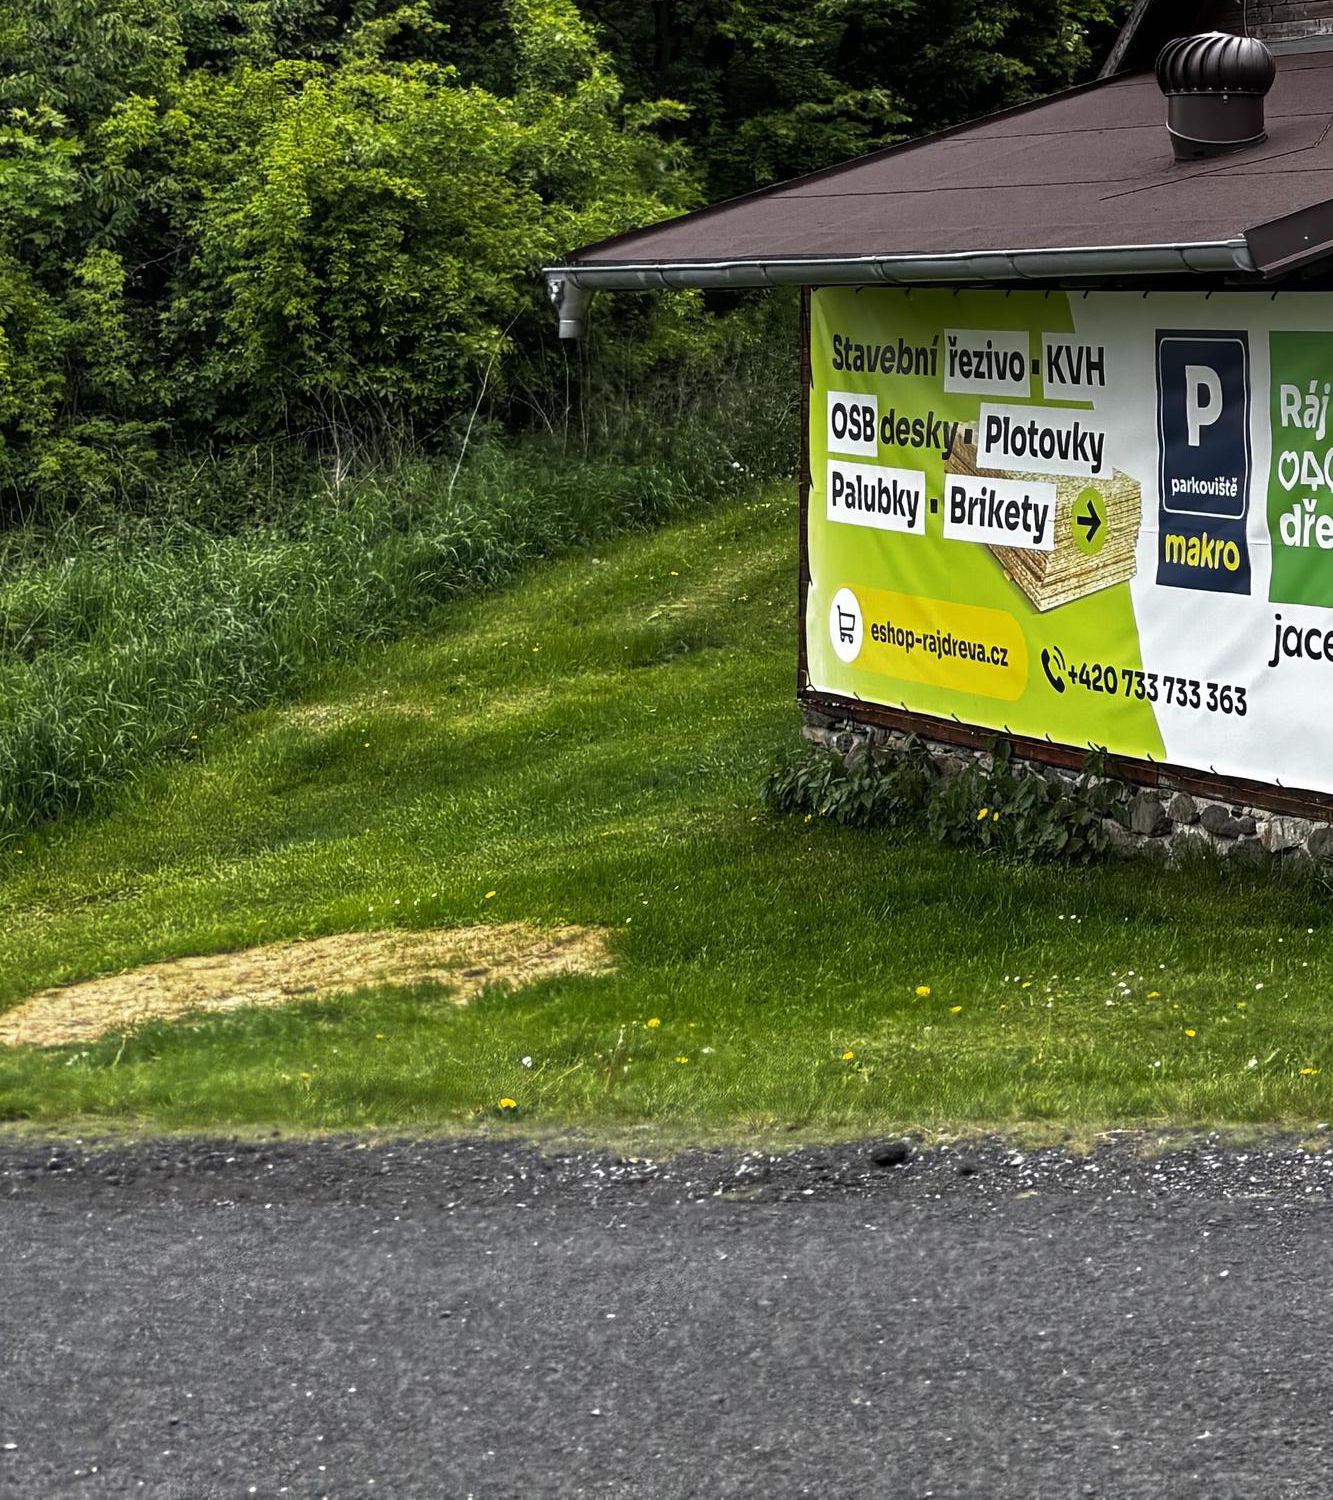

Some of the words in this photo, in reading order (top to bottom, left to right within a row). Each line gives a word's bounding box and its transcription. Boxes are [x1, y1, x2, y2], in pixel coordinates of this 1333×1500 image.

[833, 334, 939, 377] Stavební
[948, 336, 1025, 382] řezivo
[1047, 344, 1106, 386] KVH
[1185, 365, 1223, 447] P
[1280, 380, 1331, 441] Ráj
[831, 402, 875, 442] OSB
[881, 409, 959, 460] desky
[985, 415, 1105, 474] Plotovky
[832, 471, 919, 528] Palubky
[950, 486, 1049, 544] Brikety
[1172, 476, 1238, 497] parkoviště
[1165, 531, 1241, 571] makro
[870, 620, 1009, 667] eshop-rajdreva.cz
[1067, 664, 1118, 695] +420
[1121, 668, 1159, 702] 733
[1163, 676, 1201, 708] 733
[1206, 683, 1248, 717] 363
